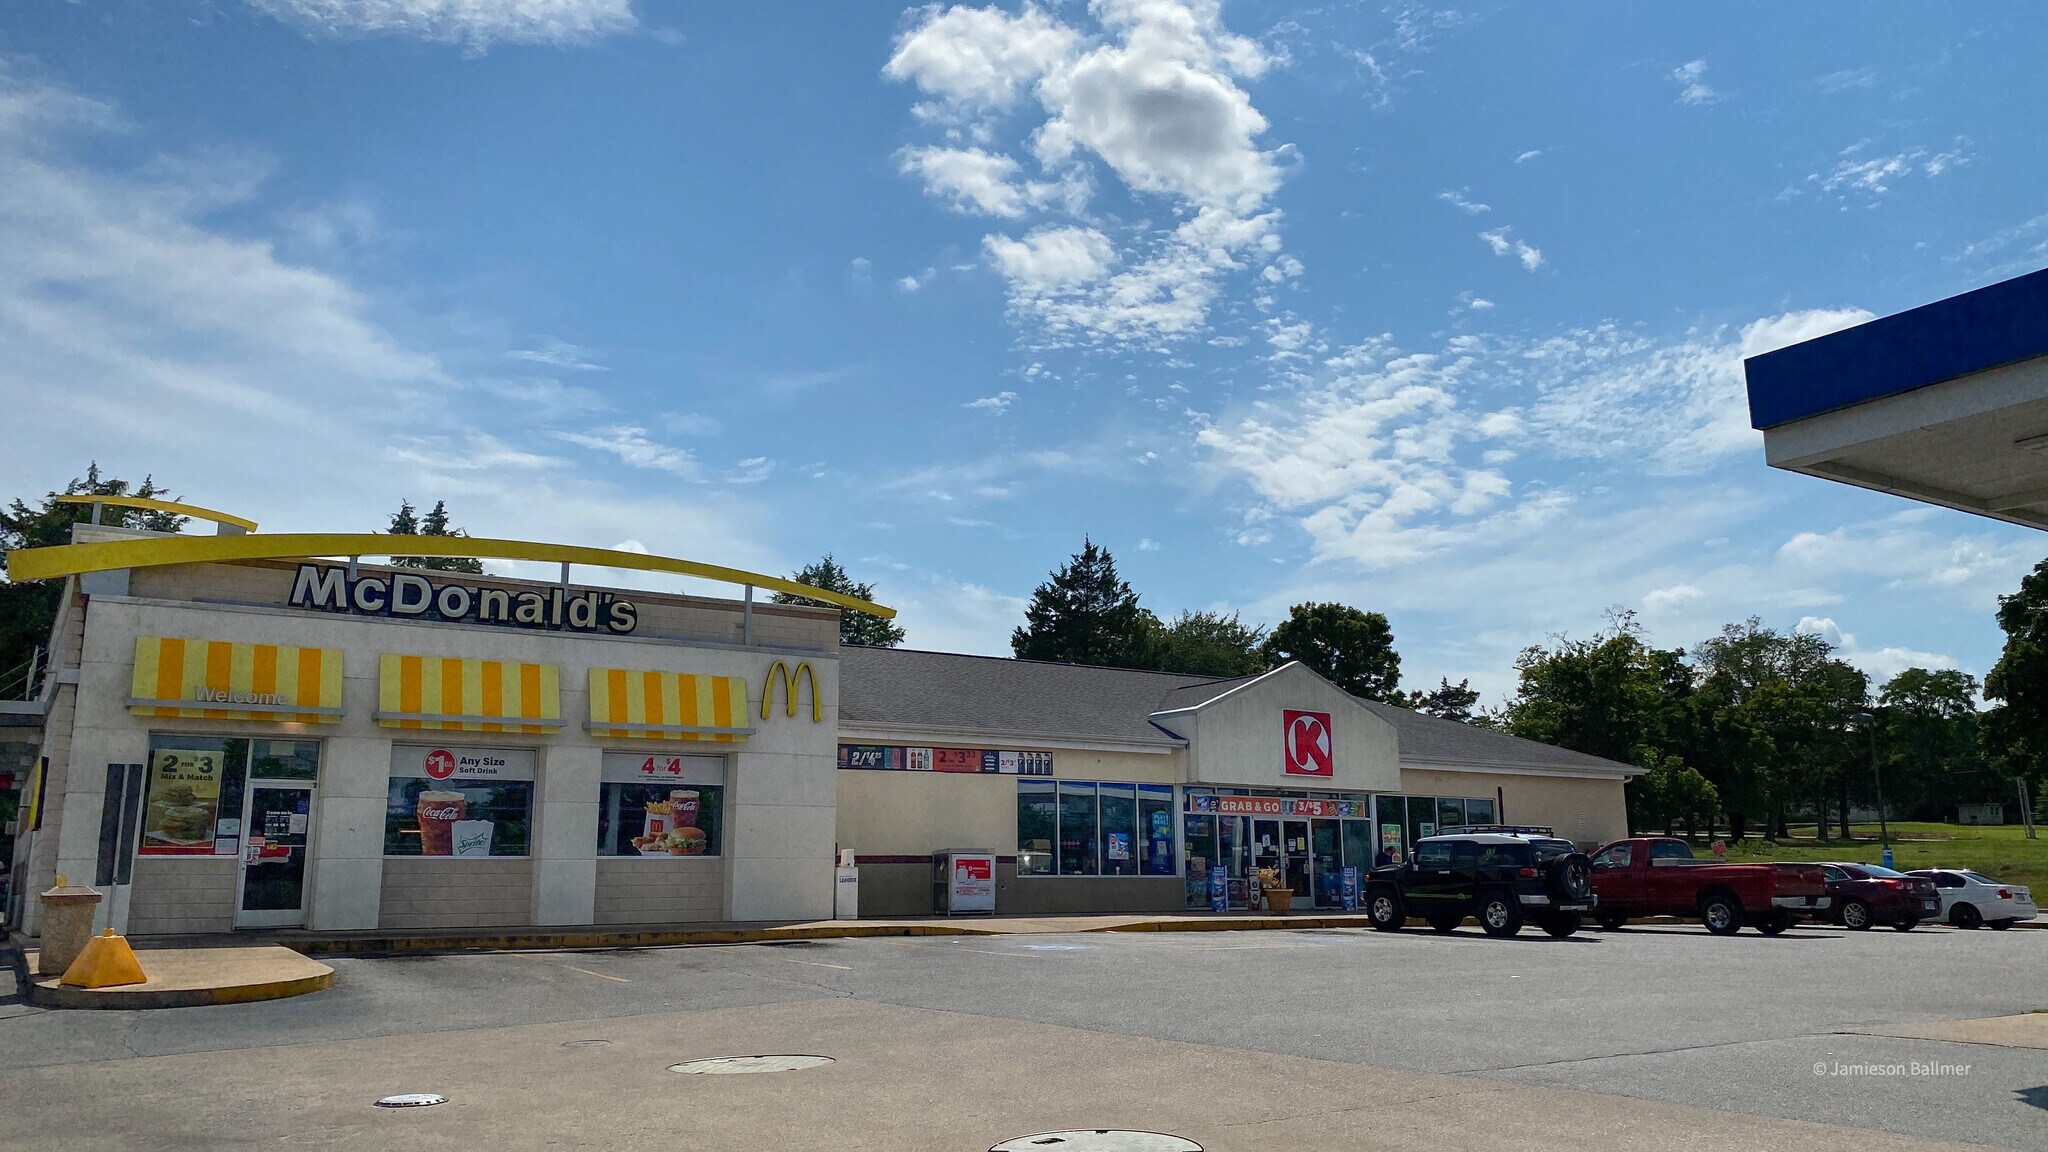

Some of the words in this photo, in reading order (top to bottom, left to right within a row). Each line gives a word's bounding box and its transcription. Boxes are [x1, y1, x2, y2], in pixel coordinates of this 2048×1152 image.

[289, 564, 637, 633] McDonald's
[194, 685, 288, 705] Welcome
[162, 755, 178, 773] 2
[460, 757, 481, 767] Any
[483, 757, 505, 766] Size
[641, 757, 655, 774] 4
[666, 758, 682, 775] $4
[477, 767, 498, 775] Drink
[1221, 800, 1252, 811] GRAB
[1254, 802, 1261, 811] &
[1264, 802, 1279, 812] GO
[1298, 801, 1322, 815] 3/$5
[460, 838, 485, 849] Sprite
